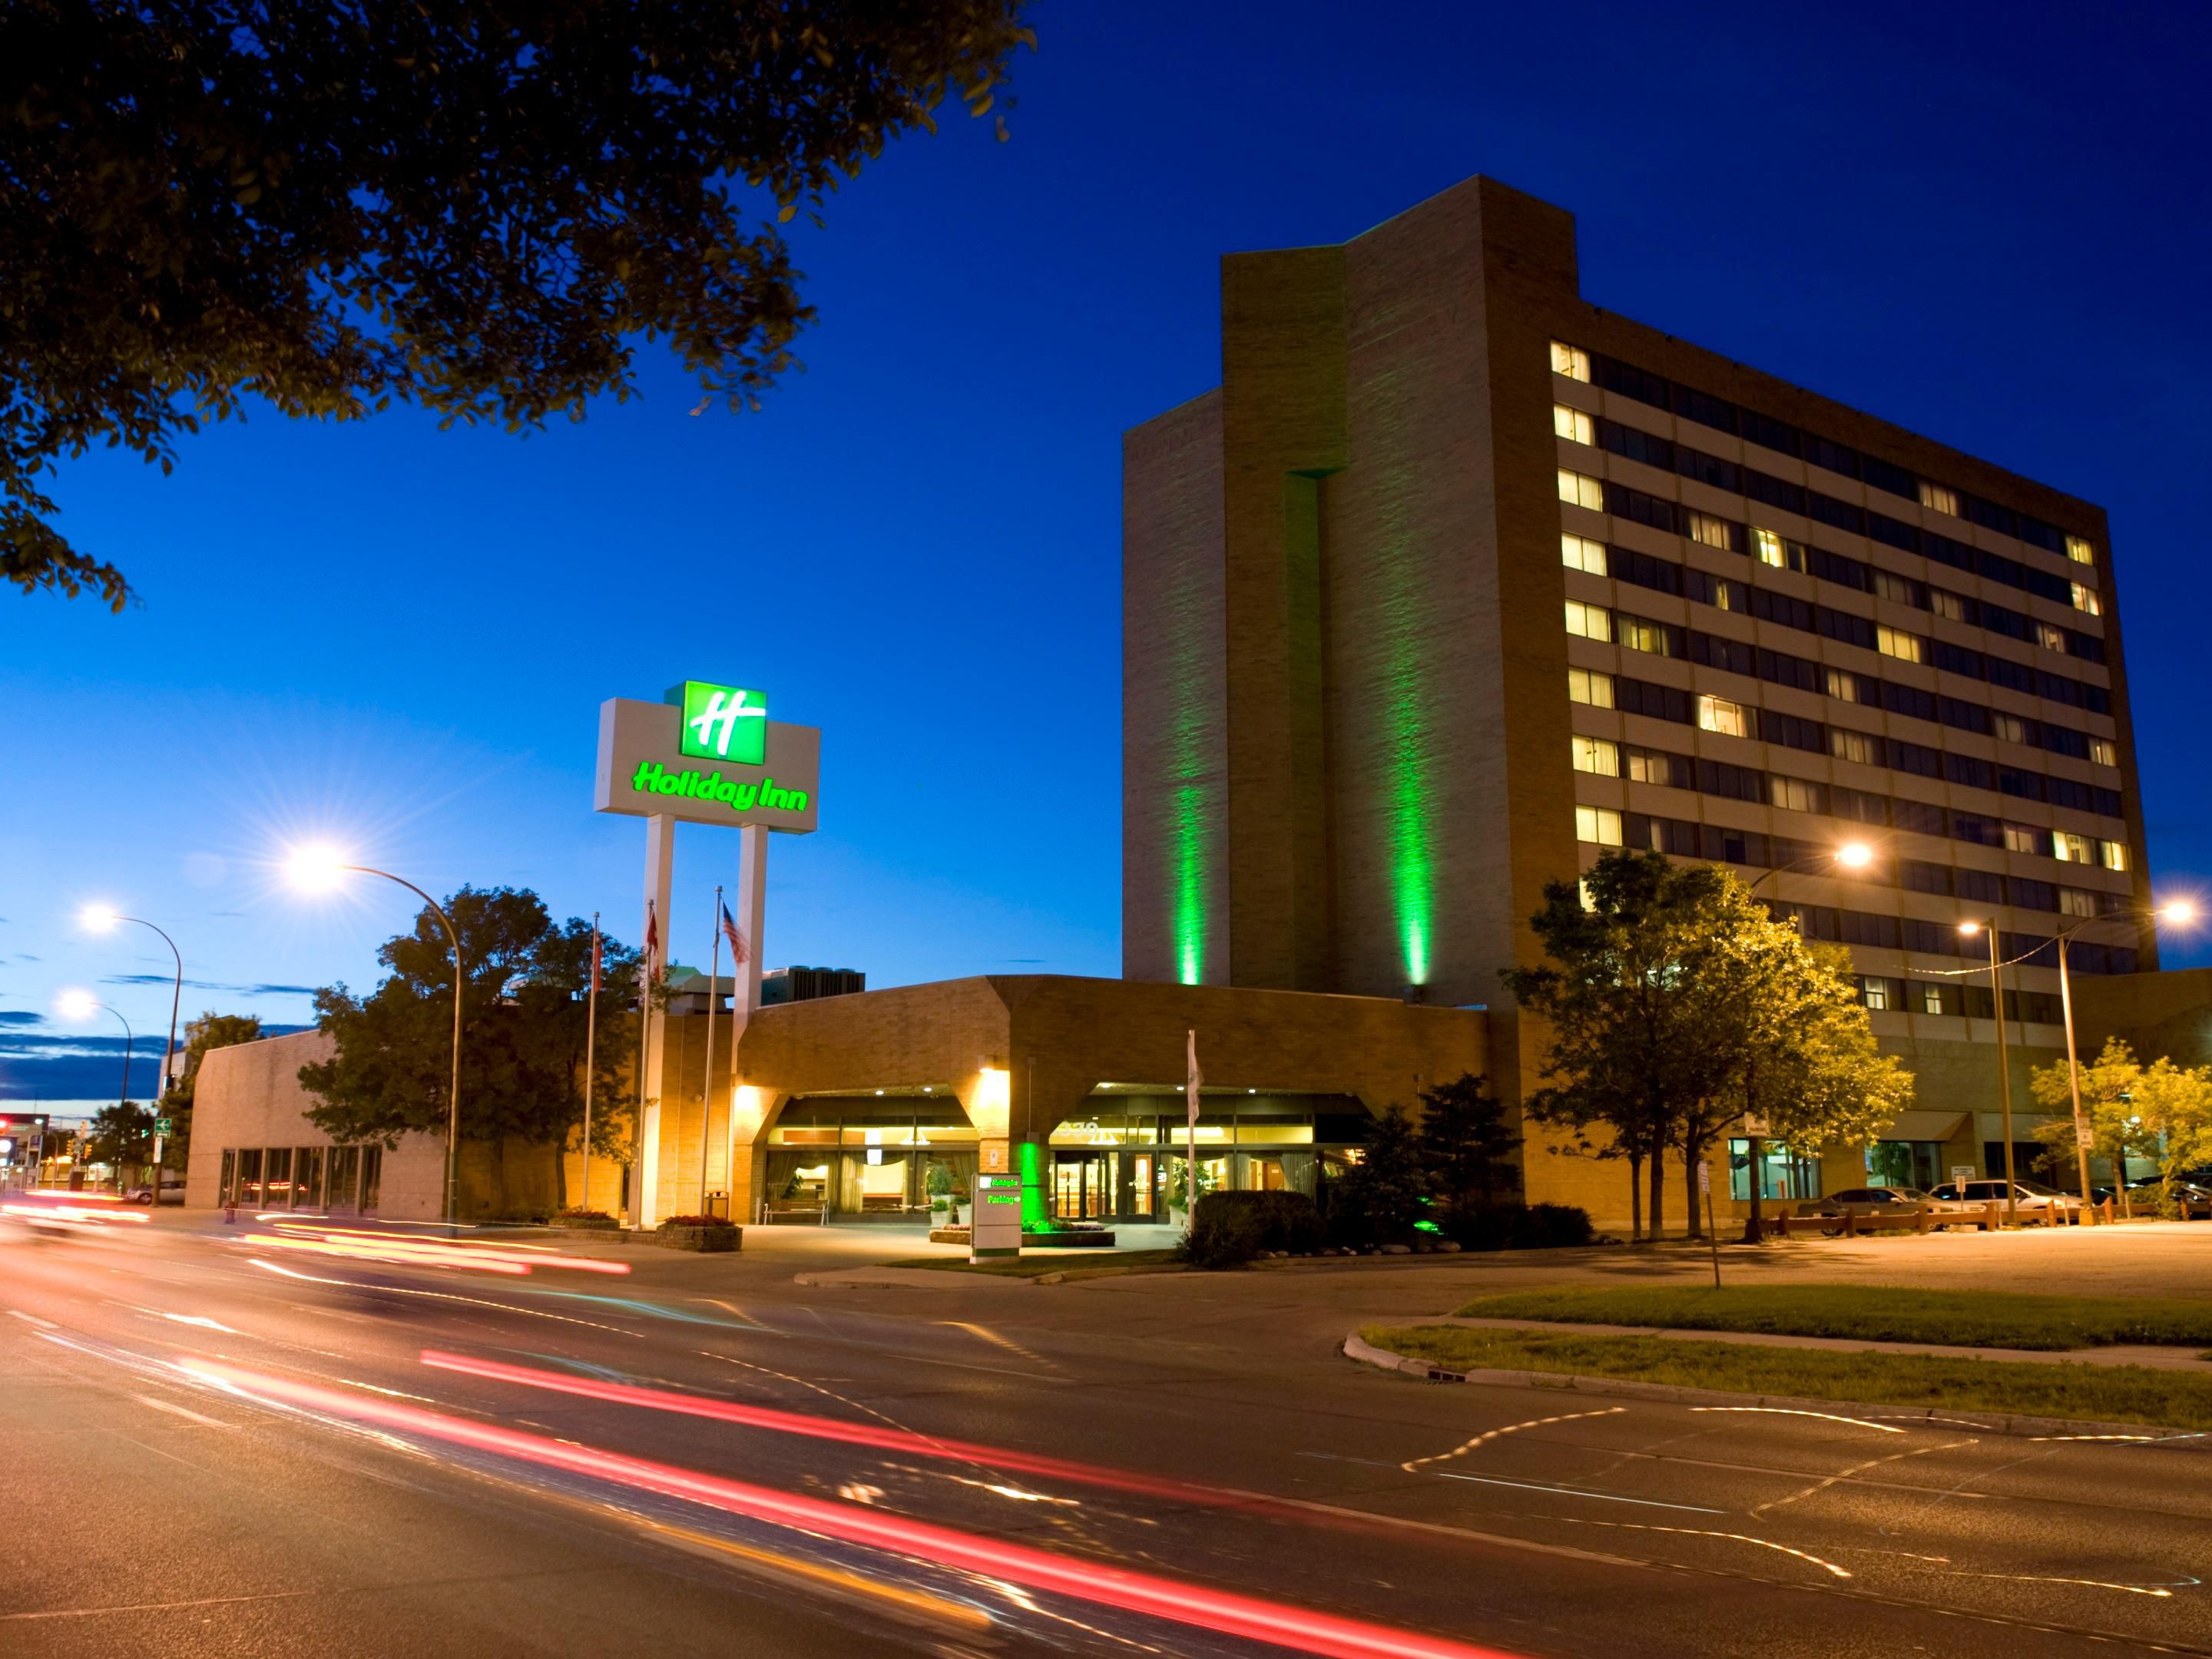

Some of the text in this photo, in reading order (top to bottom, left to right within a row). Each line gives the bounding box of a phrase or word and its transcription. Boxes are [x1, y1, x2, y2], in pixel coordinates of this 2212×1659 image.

[632, 761, 808, 811] Holiday Inn
[988, 1195, 1014, 1205] Parking
